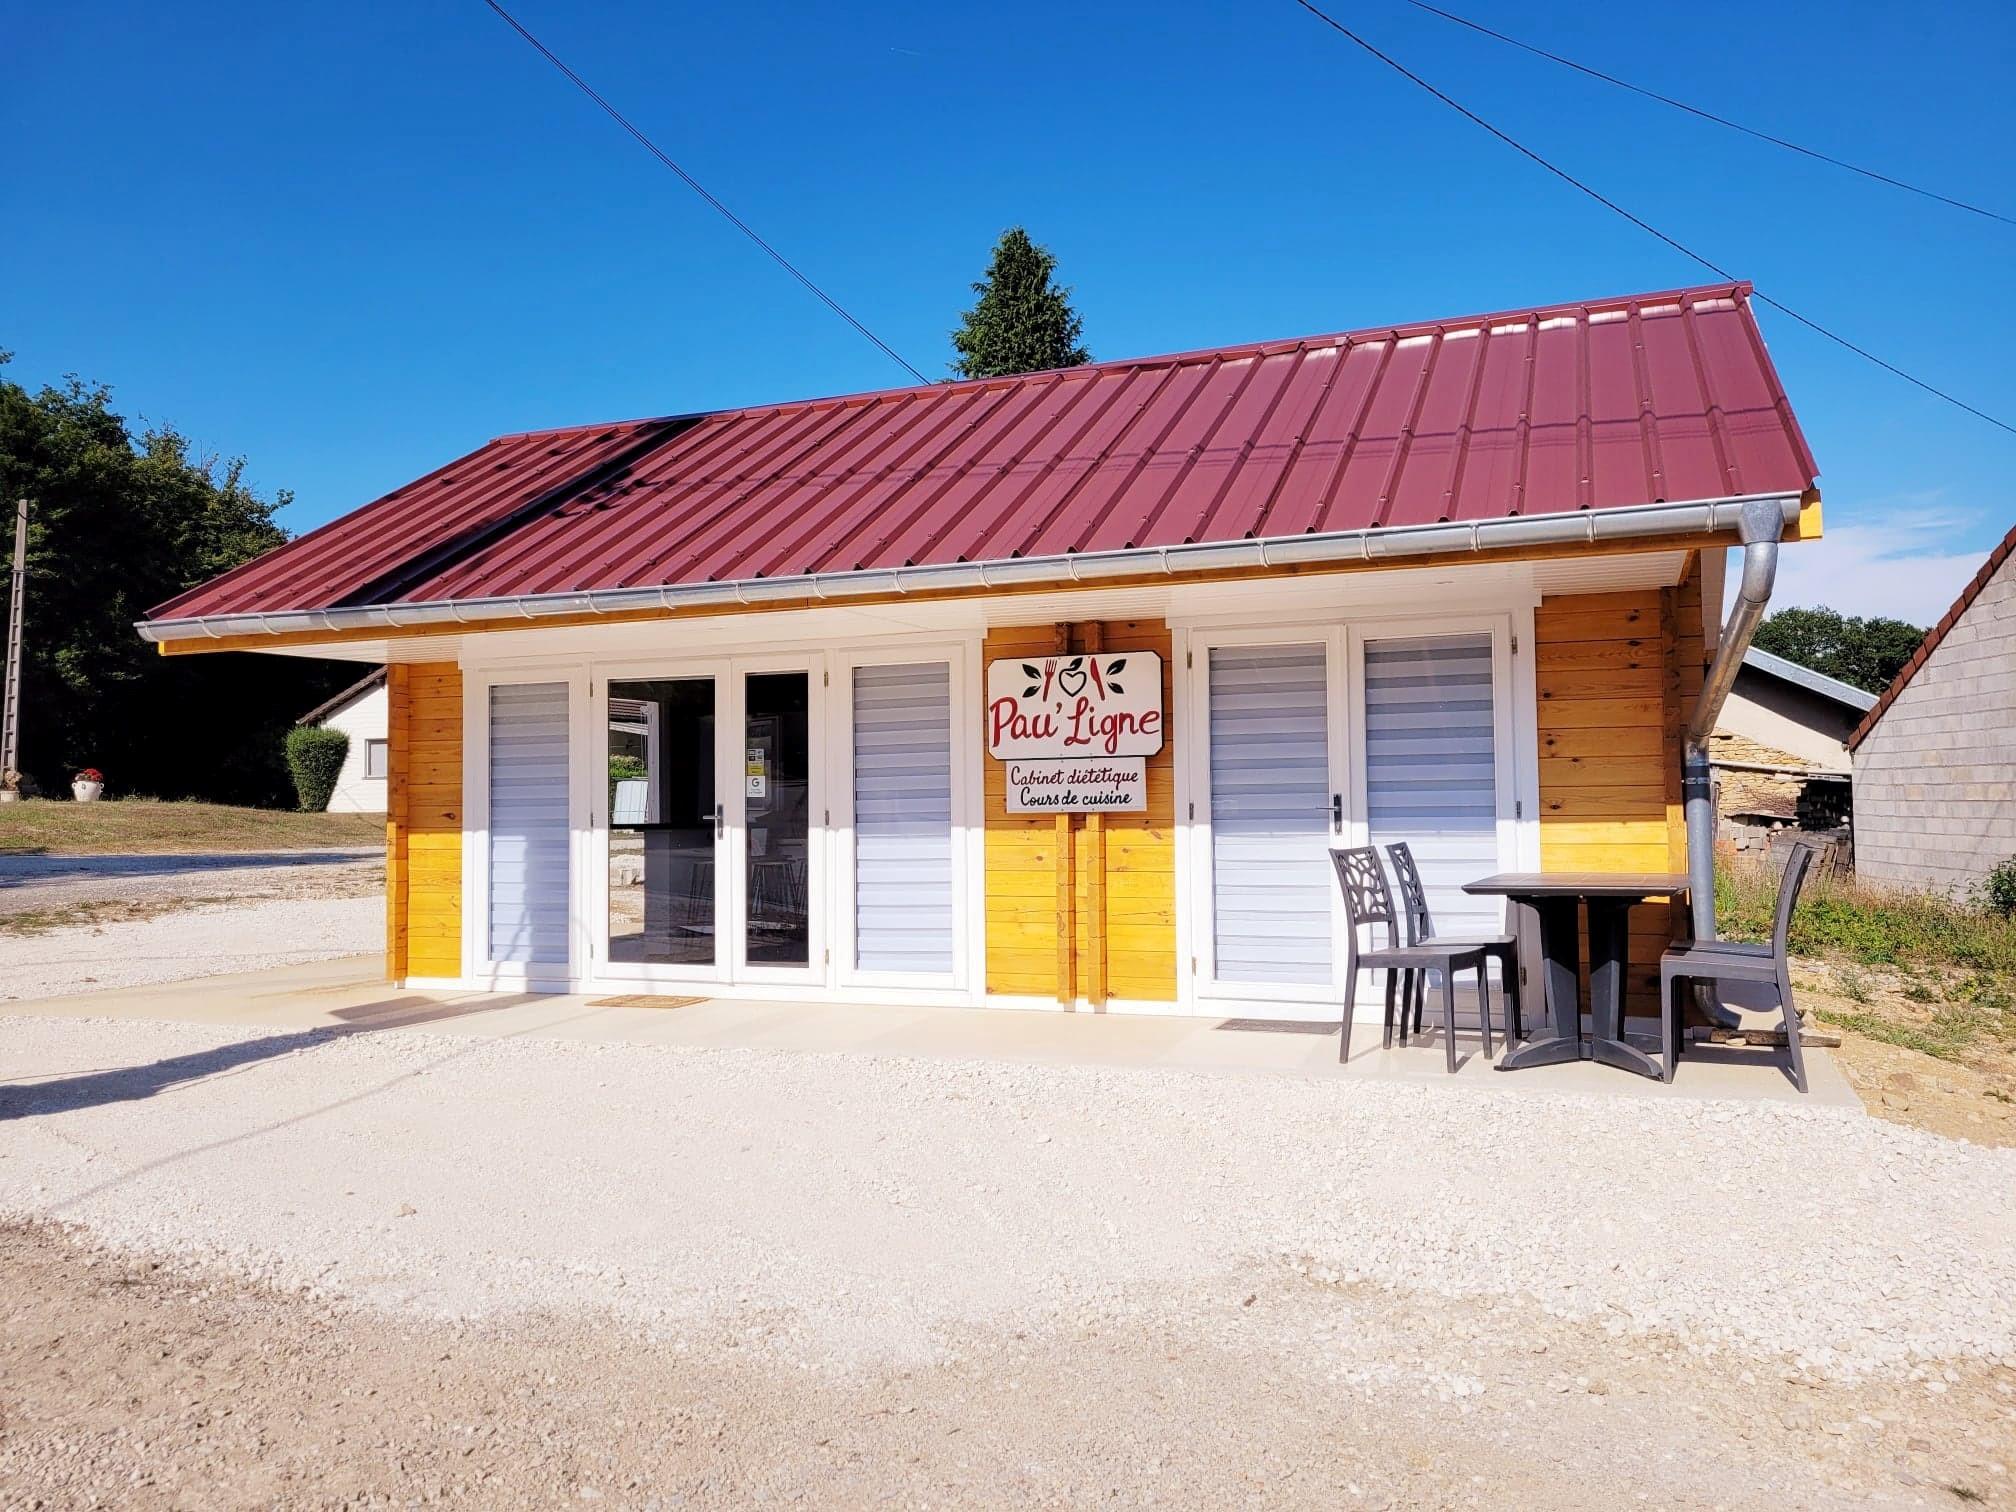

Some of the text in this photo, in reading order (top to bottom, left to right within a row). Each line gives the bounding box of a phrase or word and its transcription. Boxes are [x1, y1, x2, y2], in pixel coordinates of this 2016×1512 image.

[1011, 765, 1138, 790] Cabinet diététique
[1020, 786, 1132, 806] Cours de cuisine
